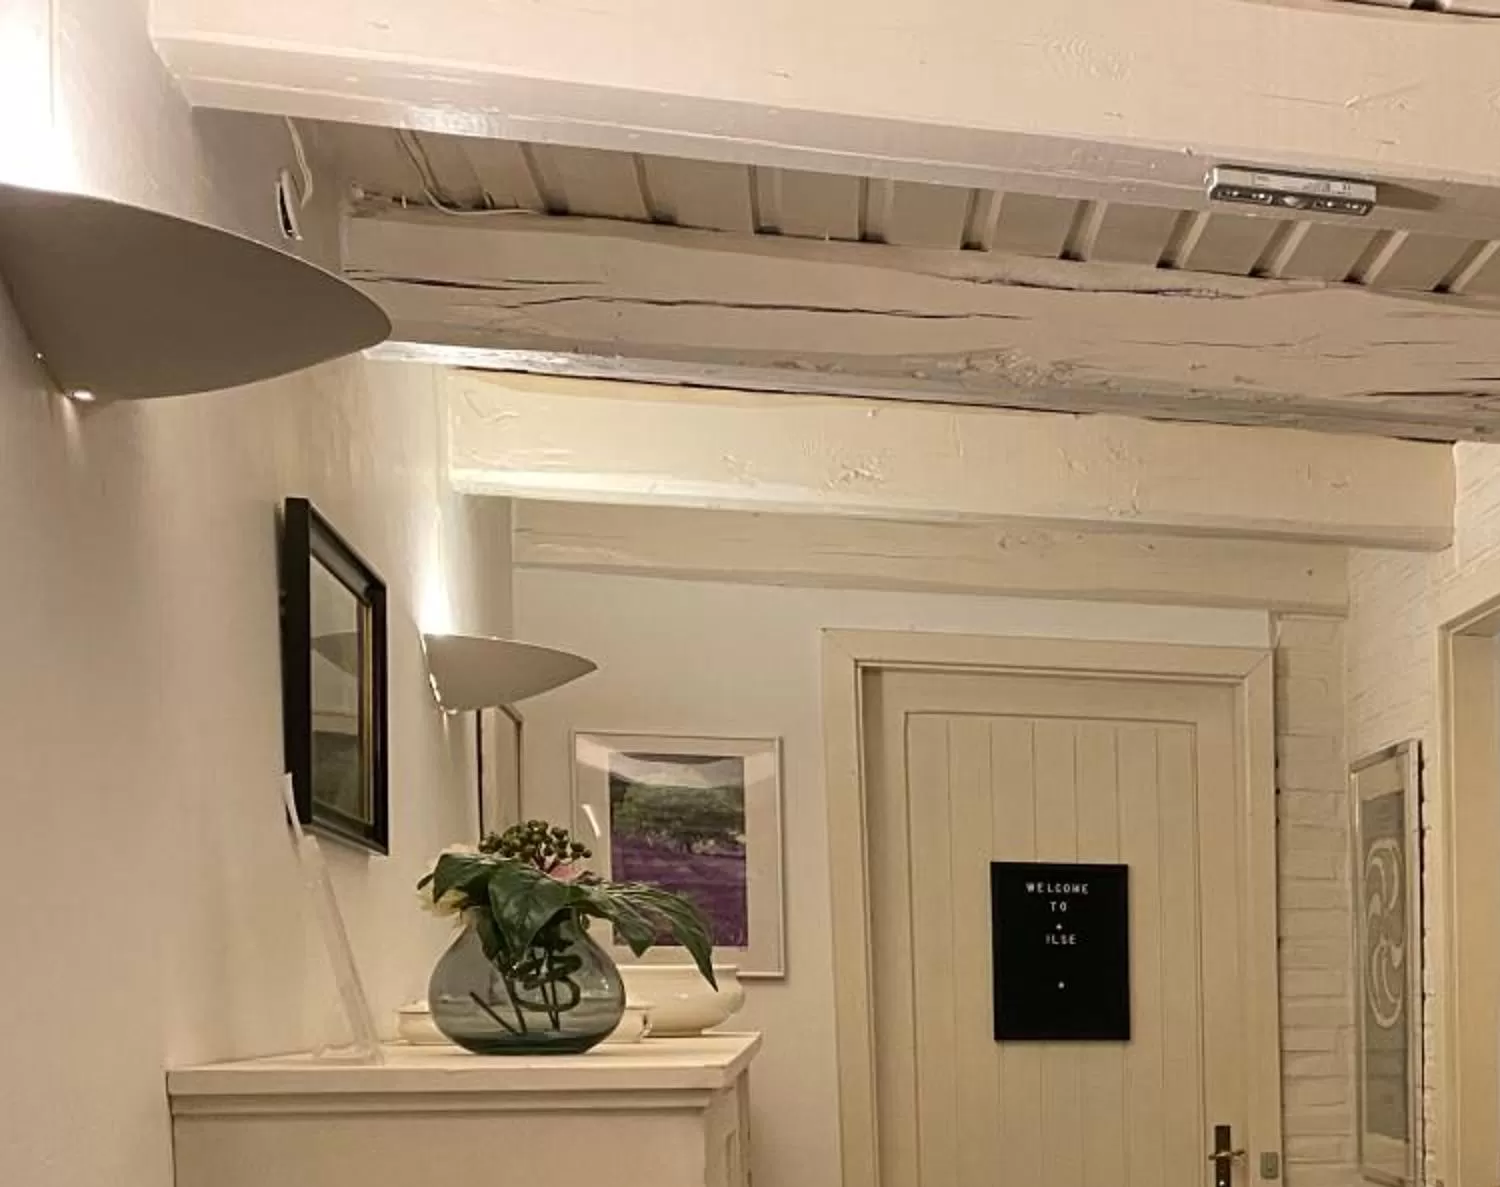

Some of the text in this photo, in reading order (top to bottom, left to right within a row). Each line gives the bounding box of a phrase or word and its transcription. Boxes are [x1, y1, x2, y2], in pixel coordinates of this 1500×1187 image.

[1025, 882, 1089, 894] WELCOME
[1049, 901, 1068, 912] TO
[1045, 933, 1077, 945] ILSE
